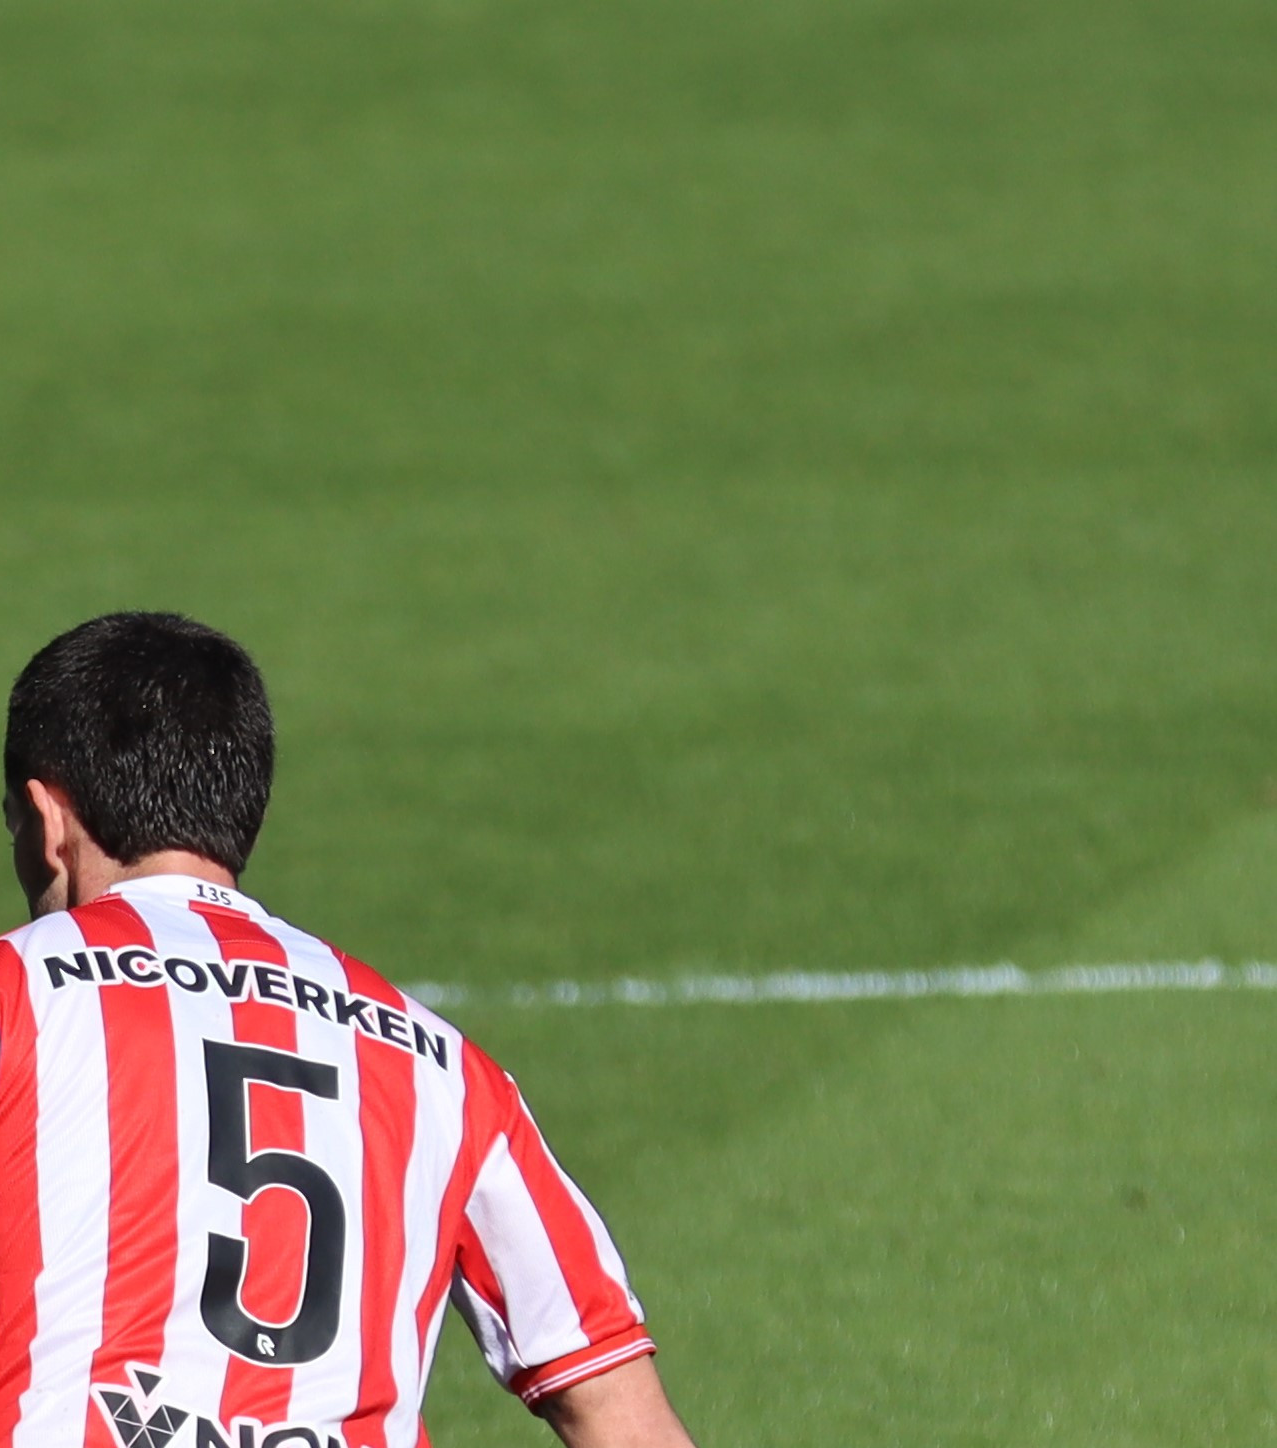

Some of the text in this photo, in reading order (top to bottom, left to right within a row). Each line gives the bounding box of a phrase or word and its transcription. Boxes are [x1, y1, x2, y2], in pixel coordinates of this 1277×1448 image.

[196, 883, 232, 906] 135
[43, 949, 448, 1071] NICOVERKEN
[200, 1037, 346, 1368] 5
